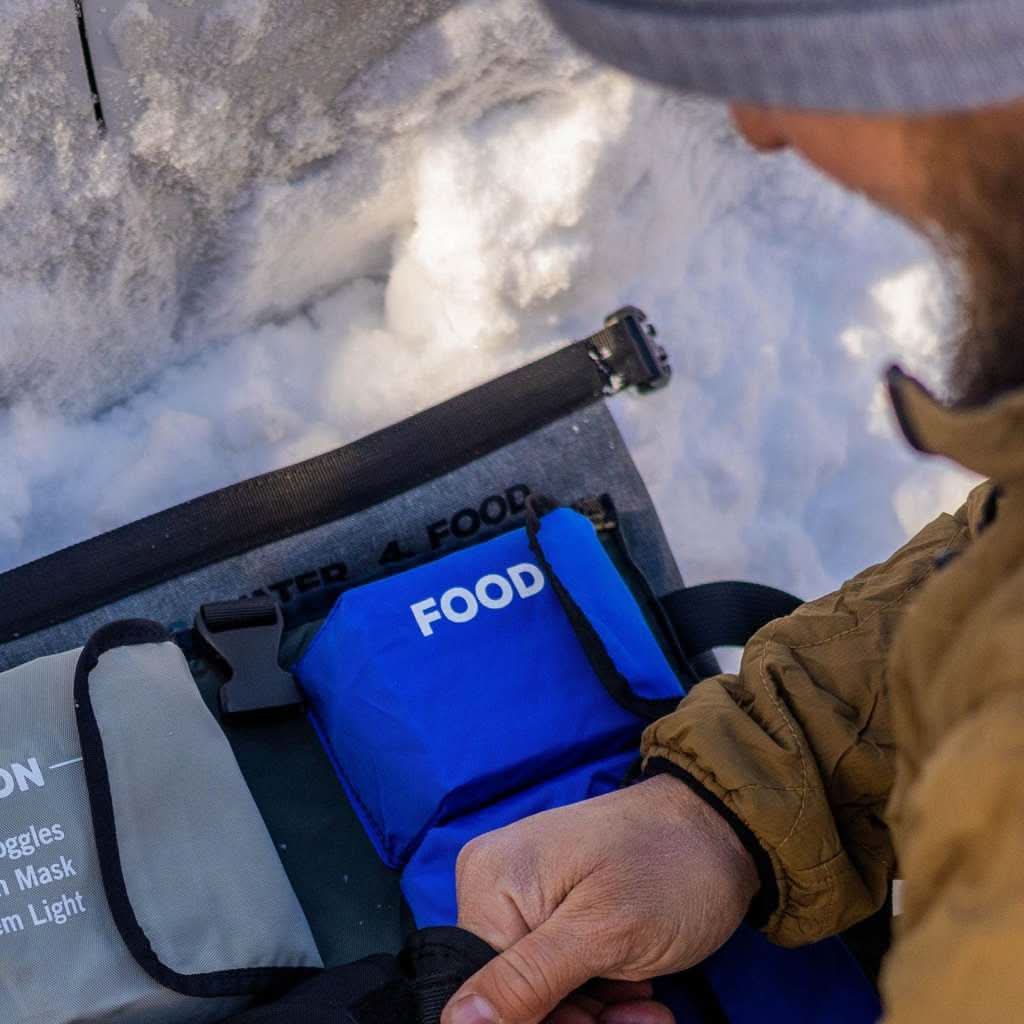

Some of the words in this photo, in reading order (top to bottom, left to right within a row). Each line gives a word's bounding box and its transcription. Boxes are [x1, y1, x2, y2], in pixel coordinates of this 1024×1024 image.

[238, 562, 348, 603] TER
[428, 484, 530, 549] FOOD
[409, 562, 545, 637] FOOD
[13, 855, 77, 891] Mask
[27, 891, 86, 926] Light
